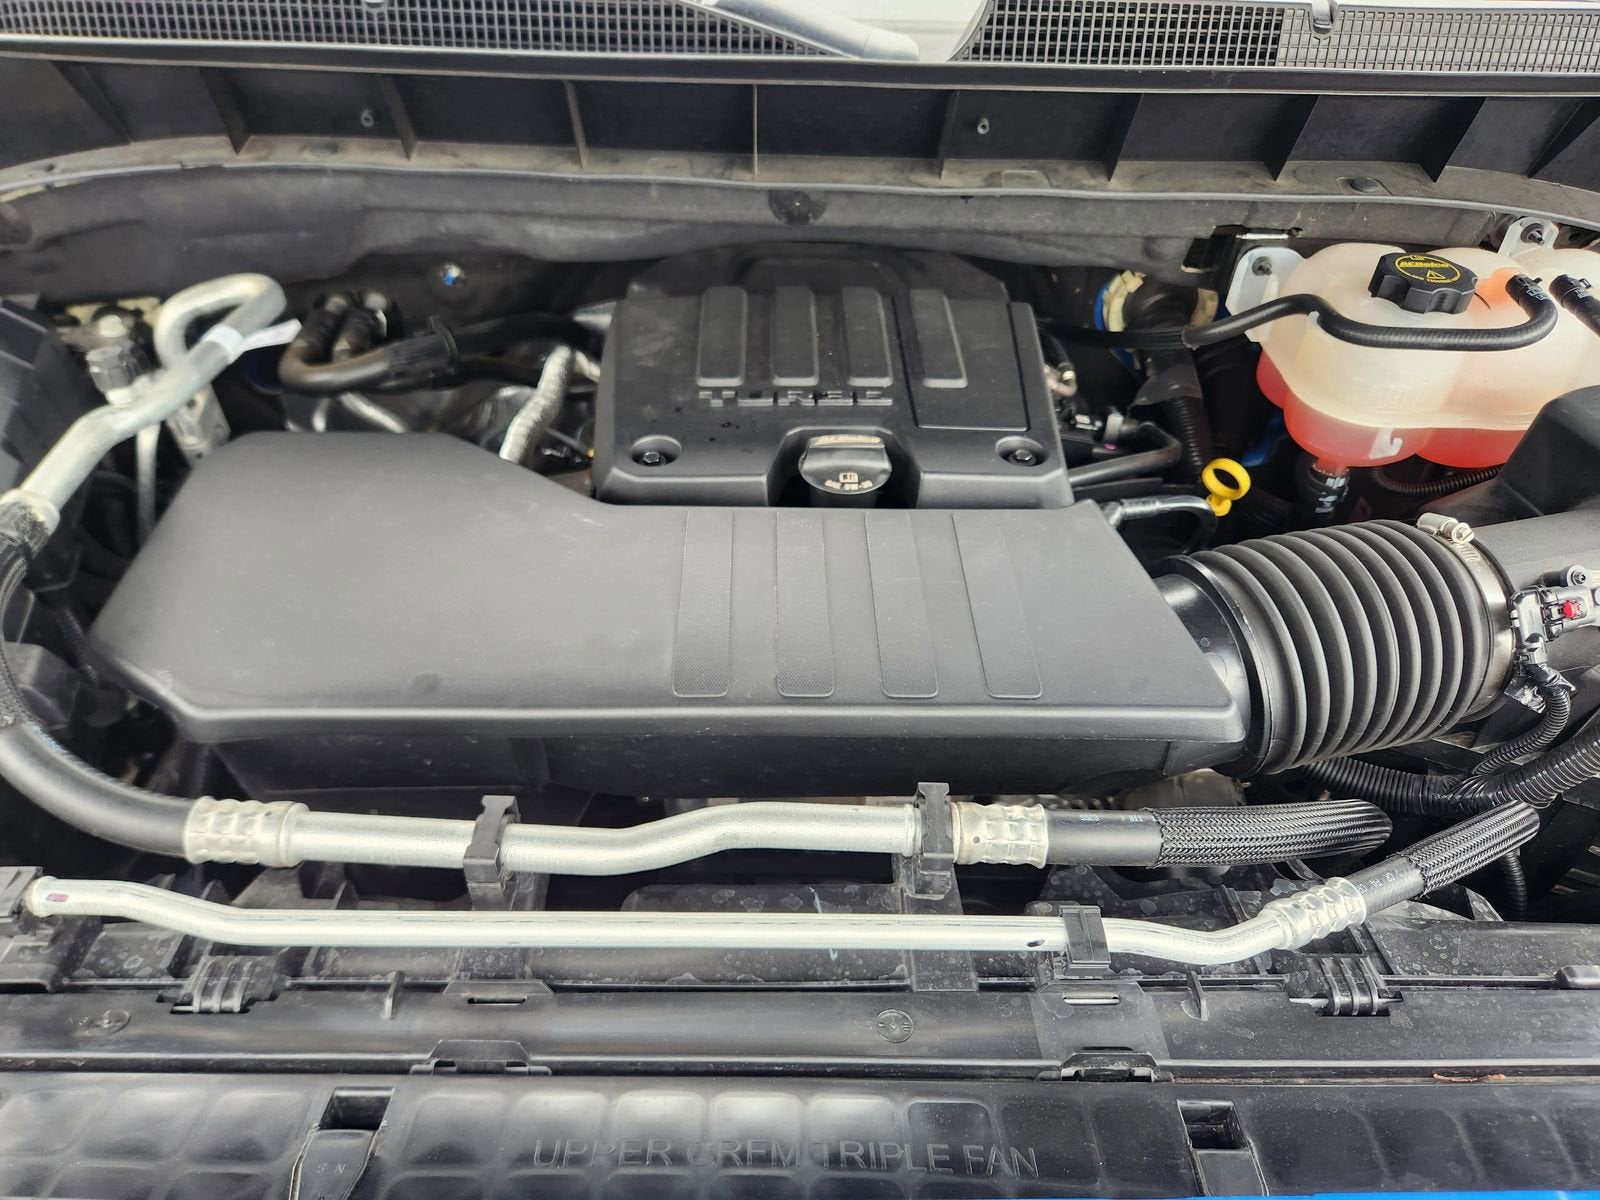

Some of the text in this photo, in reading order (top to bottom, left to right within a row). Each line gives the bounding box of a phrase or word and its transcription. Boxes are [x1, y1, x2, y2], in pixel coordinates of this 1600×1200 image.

[698, 389, 894, 407] TURBO
[532, 1138, 1040, 1179] UPPER CRFM TRIPLE FAN
